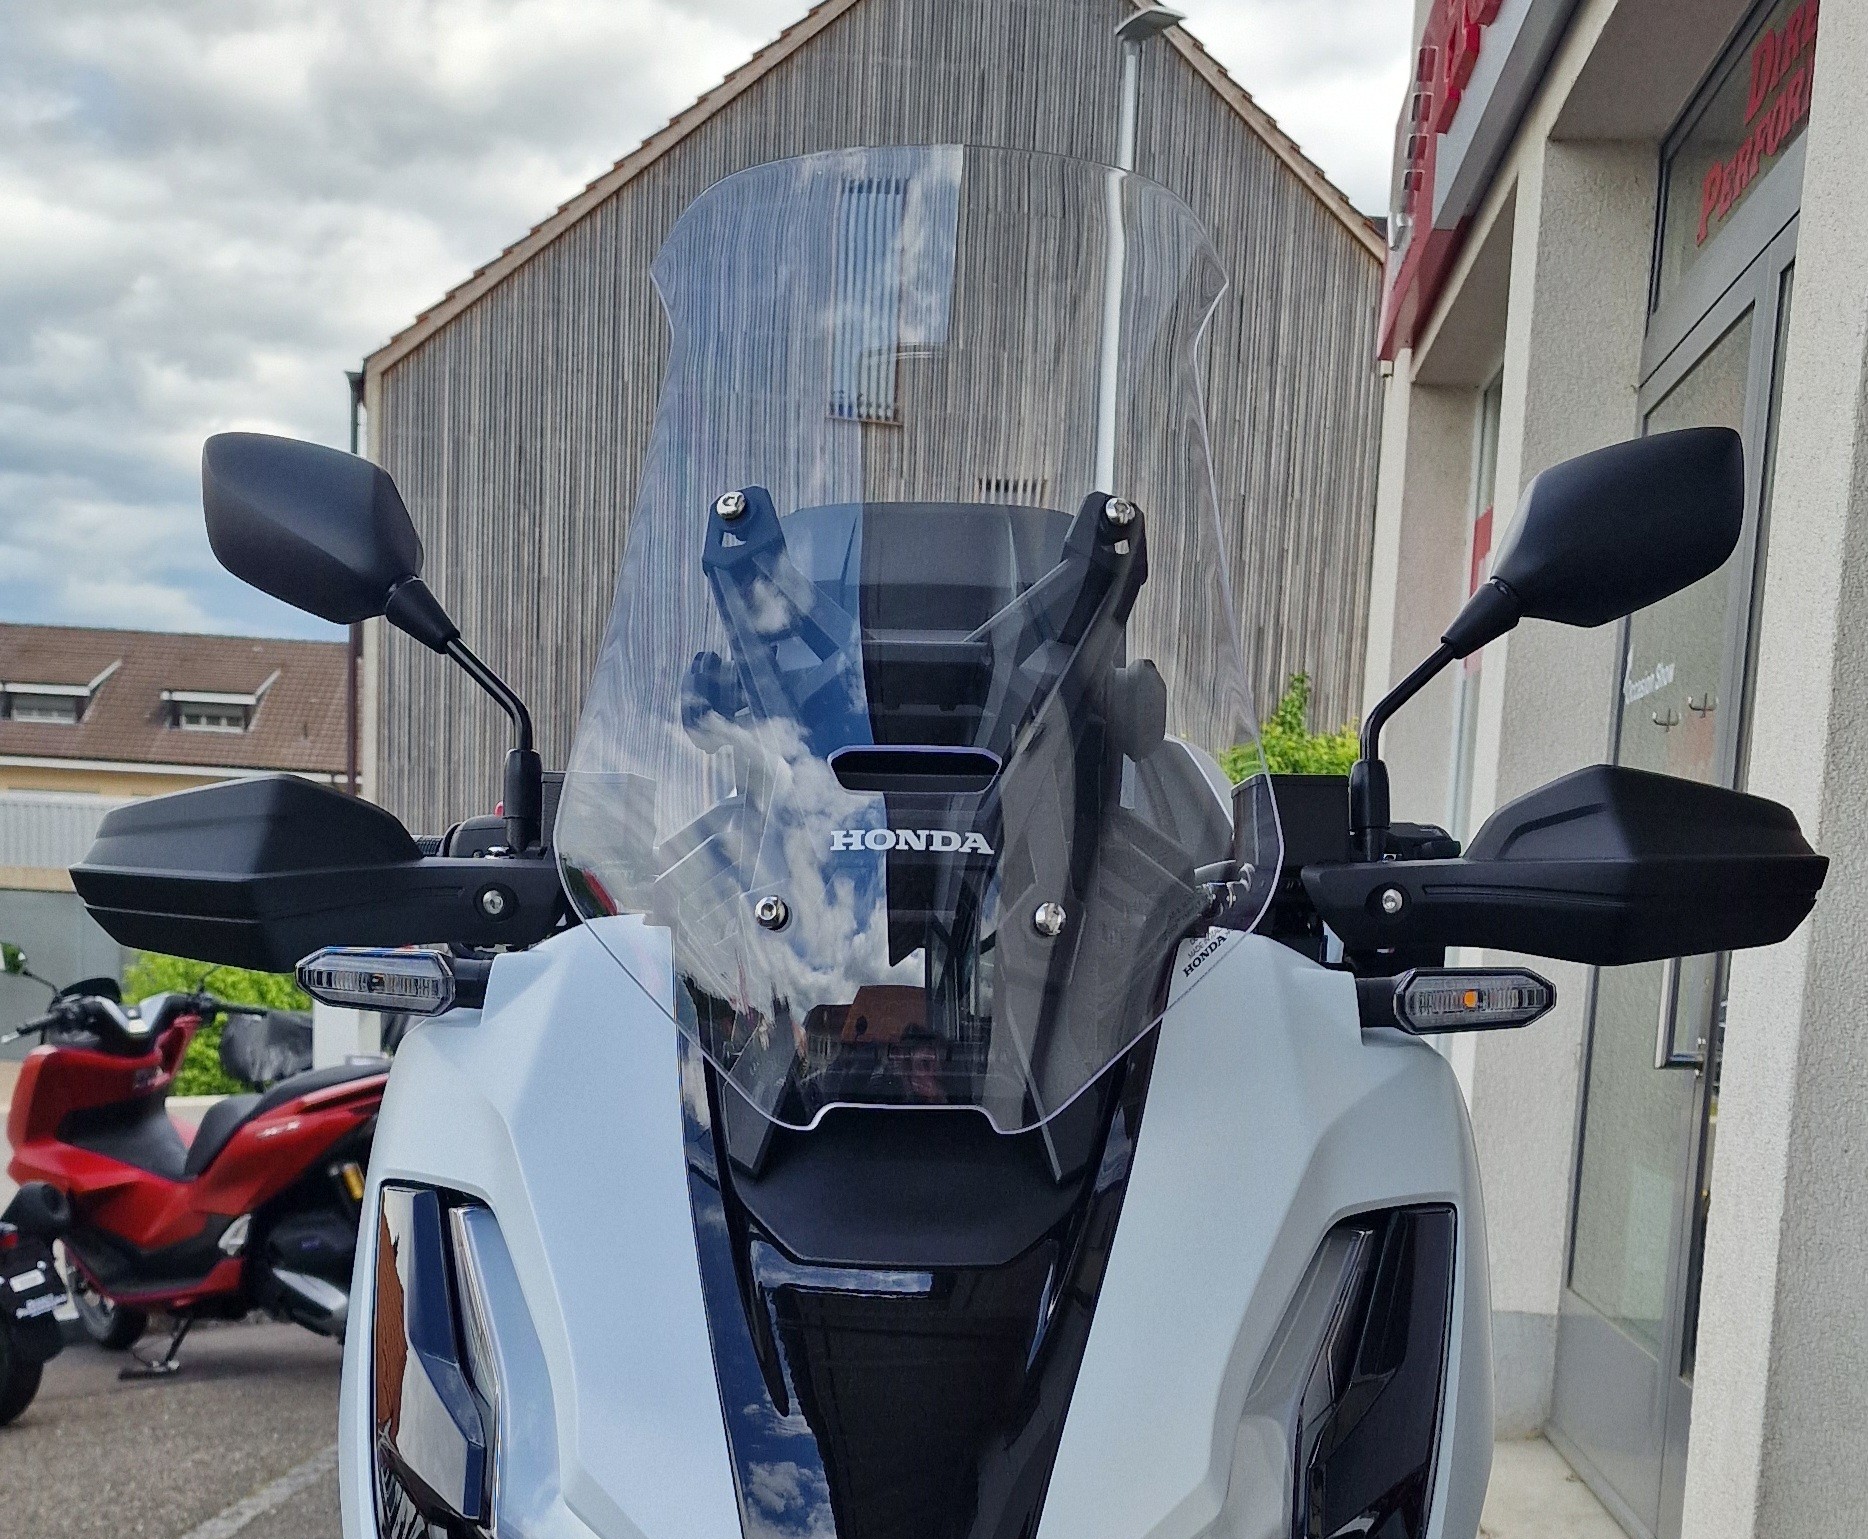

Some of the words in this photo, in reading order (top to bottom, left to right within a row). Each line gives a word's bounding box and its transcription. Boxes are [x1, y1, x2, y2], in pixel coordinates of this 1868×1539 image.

[1696, 50, 1815, 247] PERFOR
[830, 829, 995, 855] HONDA
[1182, 935, 1228, 978] HONDA
